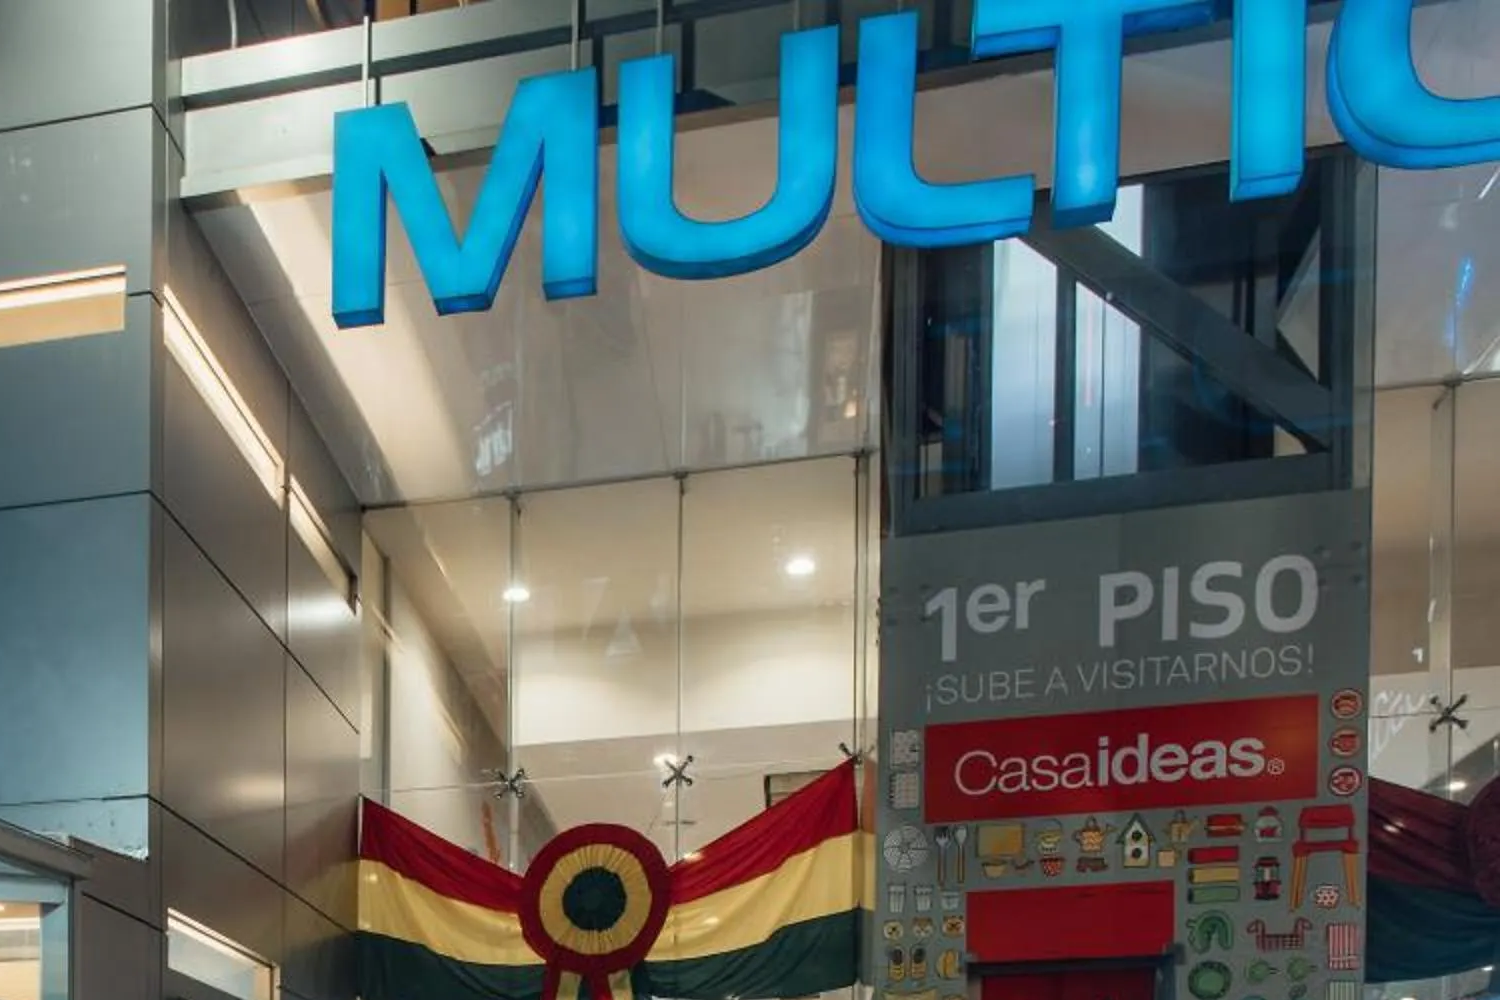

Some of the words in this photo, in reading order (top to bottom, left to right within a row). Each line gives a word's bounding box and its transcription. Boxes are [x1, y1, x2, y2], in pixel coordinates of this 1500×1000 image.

[925, 578, 1046, 662] 1er
[1099, 554, 1319, 648] PISO
[925, 668, 1035, 712] ¡SUBE
[1045, 666, 1069, 695] A
[1075, 643, 1315, 693] VISITARNOS!
